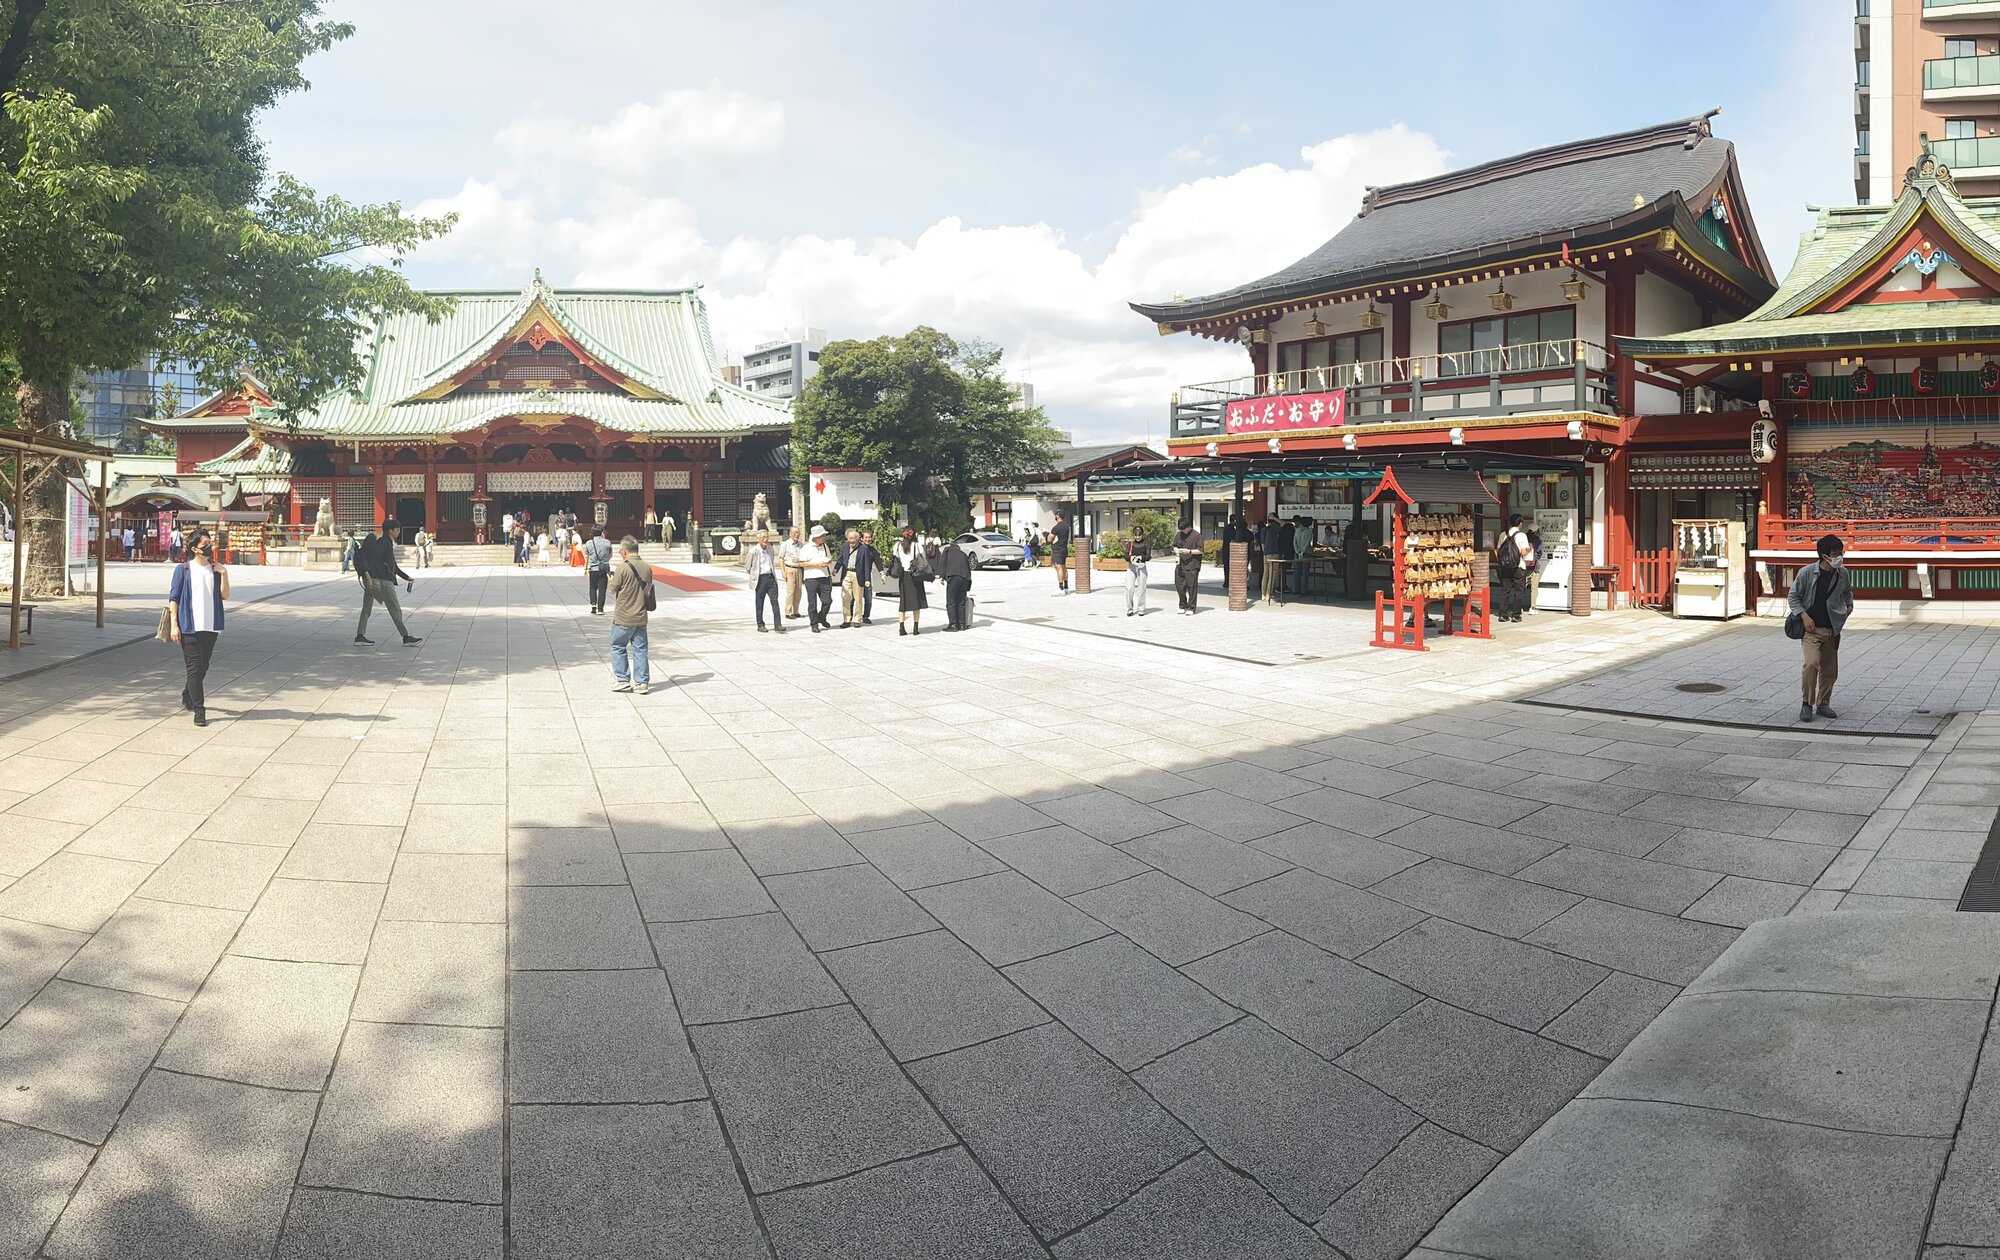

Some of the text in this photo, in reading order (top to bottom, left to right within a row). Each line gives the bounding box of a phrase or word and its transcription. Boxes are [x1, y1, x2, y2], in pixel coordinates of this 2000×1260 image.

[1230, 397, 1340, 427] おふだ・お守り
[1753, 422, 1765, 459] 神田明神
